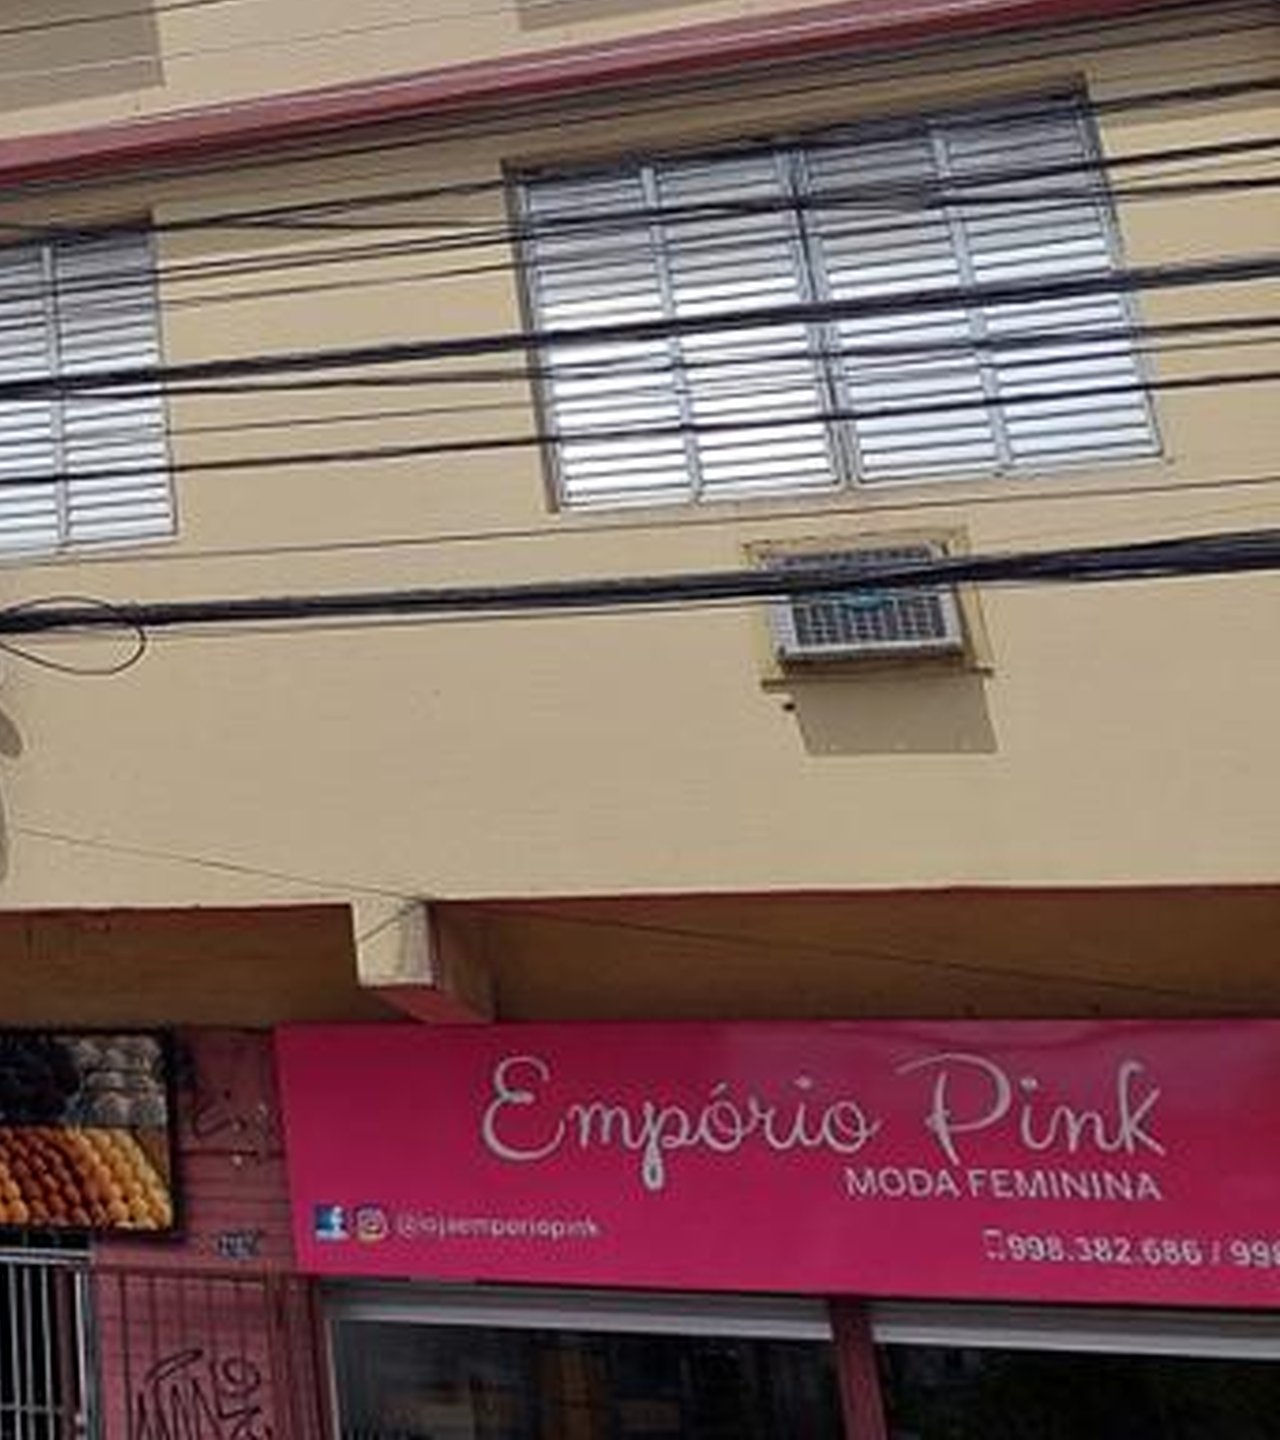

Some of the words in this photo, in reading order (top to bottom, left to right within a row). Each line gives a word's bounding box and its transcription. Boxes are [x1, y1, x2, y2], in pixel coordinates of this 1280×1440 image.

[482, 1055, 878, 1190] Empório
[894, 1052, 1166, 1166] Pink
[846, 1166, 958, 1200] MODA
[968, 1168, 1164, 1201] FEMININA
